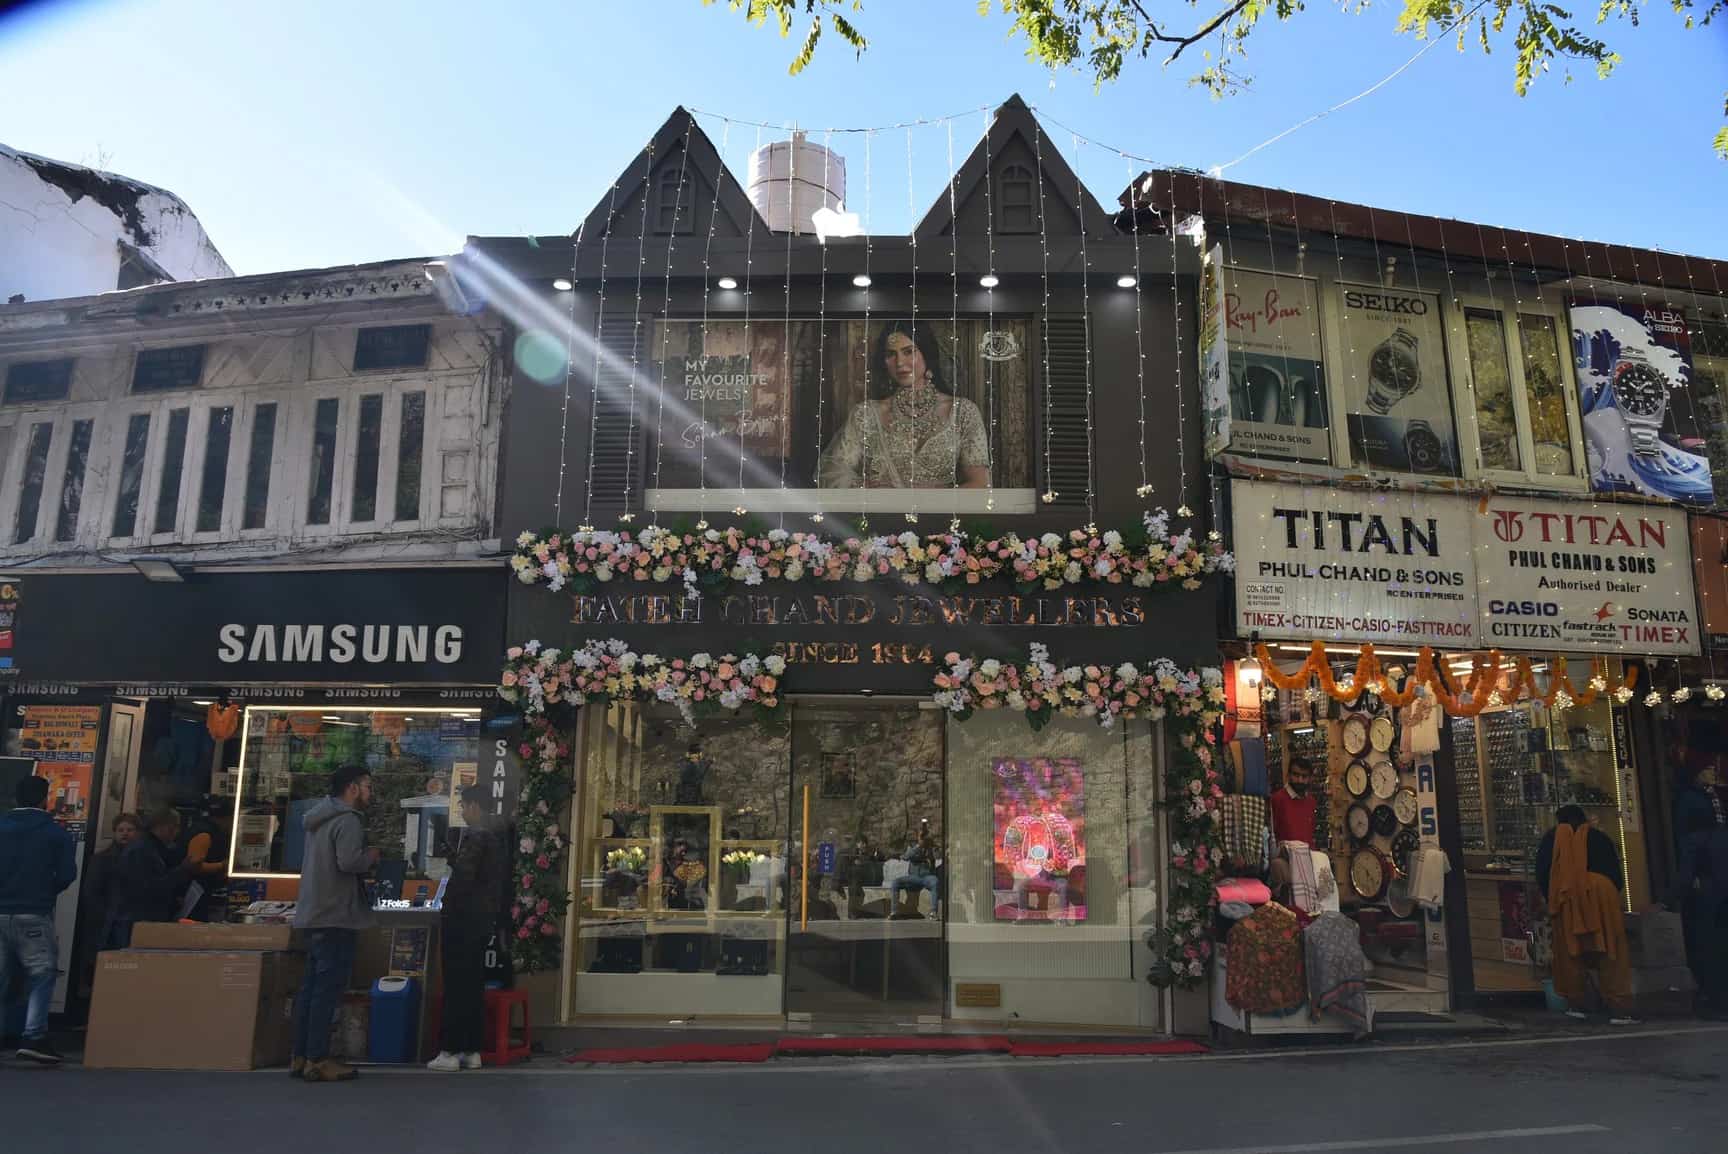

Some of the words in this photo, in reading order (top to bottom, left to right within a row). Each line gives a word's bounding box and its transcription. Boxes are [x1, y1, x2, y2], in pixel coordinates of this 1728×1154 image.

[1225, 289, 1302, 333] Ray-Ban
[1346, 292, 1427, 315] SEIKO
[1643, 310, 1685, 325] ALBA
[685, 360, 706, 371] MY
[685, 374, 768, 385] FAVOURITE
[684, 389, 741, 400] JEWELS
[1273, 508, 1440, 557] TITAN
[1529, 512, 1666, 549] TITAN
[1509, 550, 1547, 568] PHUL
[1552, 552, 1601, 571] CHAND
[1605, 558, 1615, 572] &
[1618, 556, 1656, 574] SONS
[1259, 561, 1313, 578] PHUL
[1319, 565, 1392, 582] CHAND
[1396, 569, 1409, 583] &
[1412, 570, 1464, 586] SONS
[1538, 575, 1601, 591] Authorised
[1606, 580, 1642, 593] Dealer
[570, 595, 704, 624] FATEH
[721, 595, 876, 624] CHAND
[888, 596, 1145, 626] JEWELLERS
[1488, 600, 1558, 616] CASIO
[1628, 608, 1689, 623] SONATA
[1492, 622, 1561, 639] CITIZEN
[1563, 620, 1616, 631] fastrack
[1618, 625, 1689, 644] TIMEX
[218, 624, 463, 663] SAMSUNG
